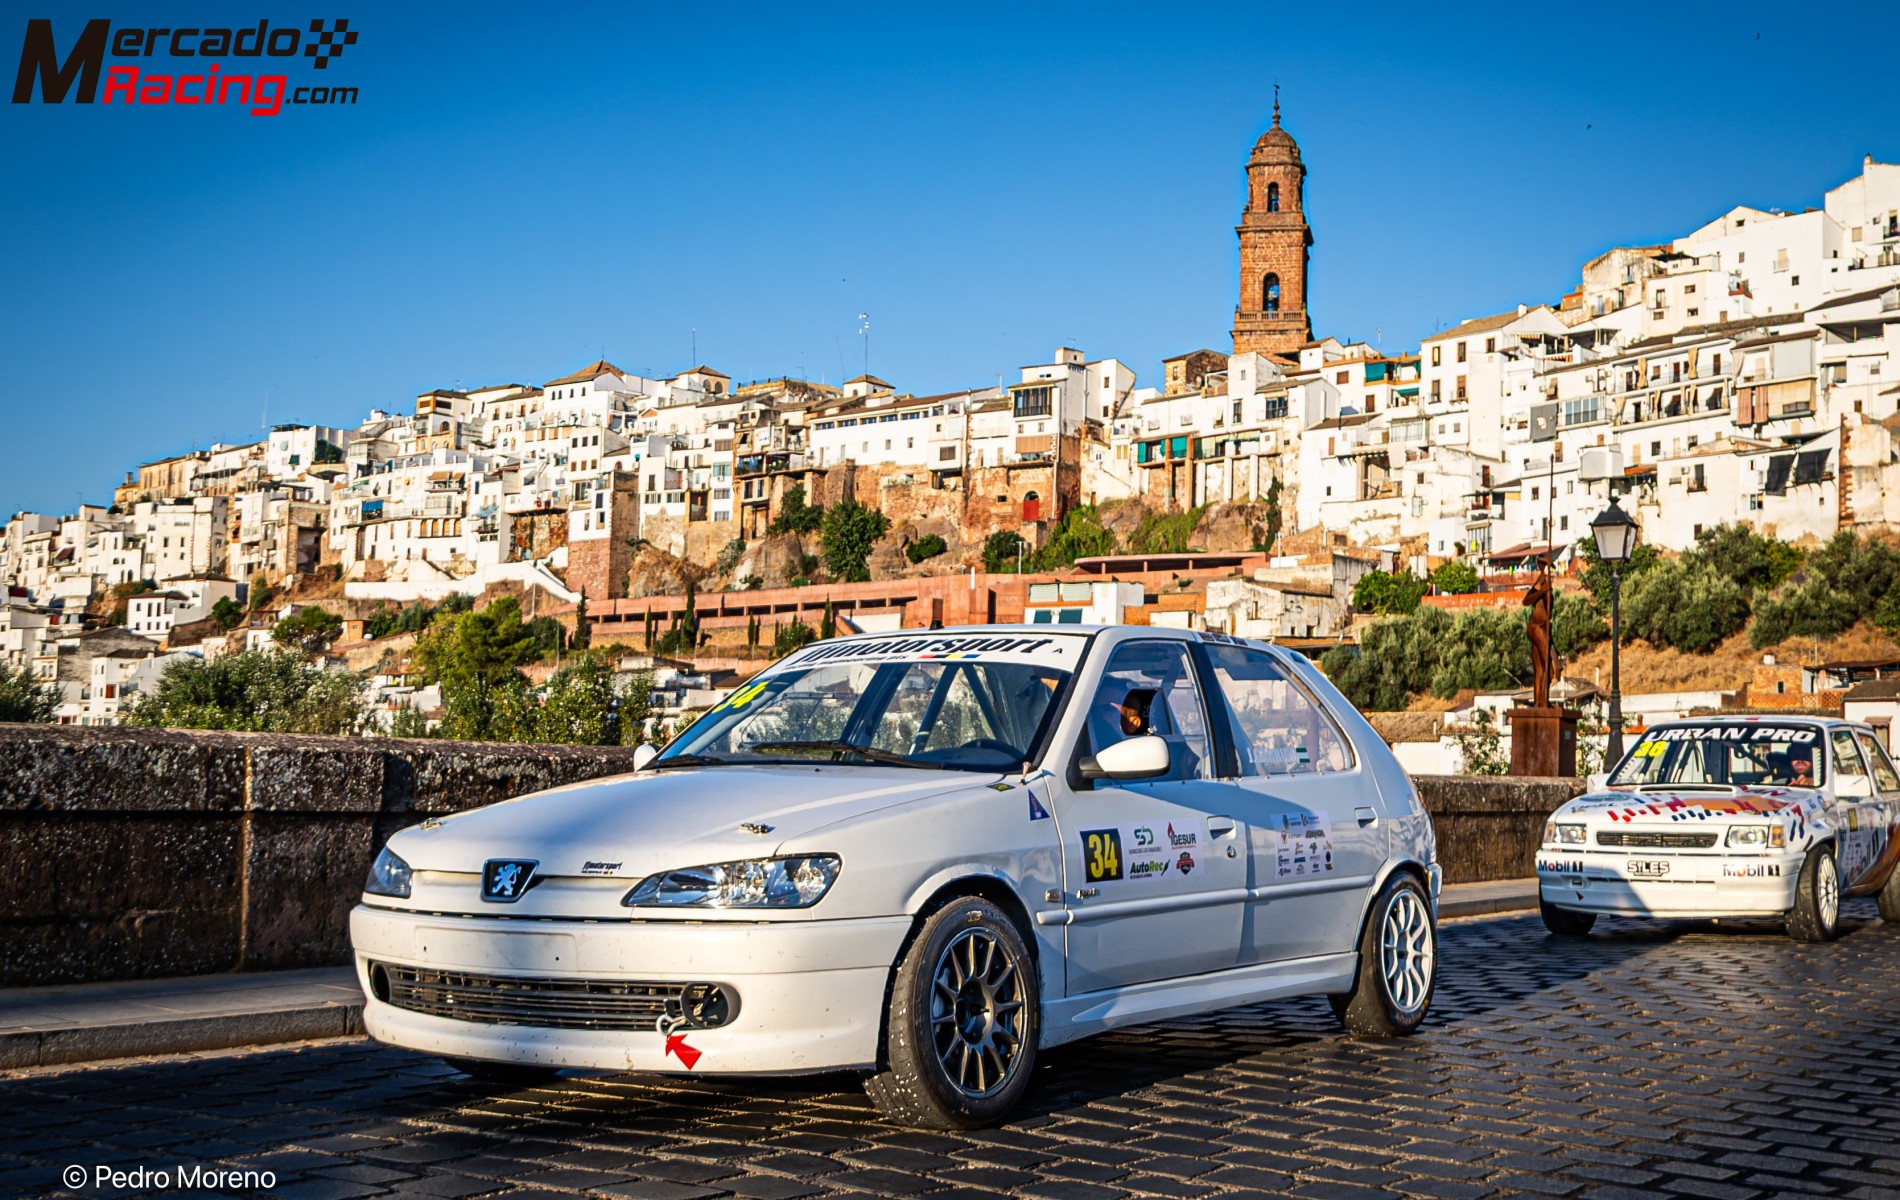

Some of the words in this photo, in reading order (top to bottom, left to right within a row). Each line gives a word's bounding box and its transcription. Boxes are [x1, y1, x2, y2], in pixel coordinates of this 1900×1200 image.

[1643, 727, 1748, 742] URBAN
[1750, 728, 1817, 743] PRO
[1088, 833, 1118, 878] 34
[1130, 860, 1164, 874] AutoRec
[1538, 859, 1570, 872] Mobil
[1723, 864, 1764, 877] Mobil
